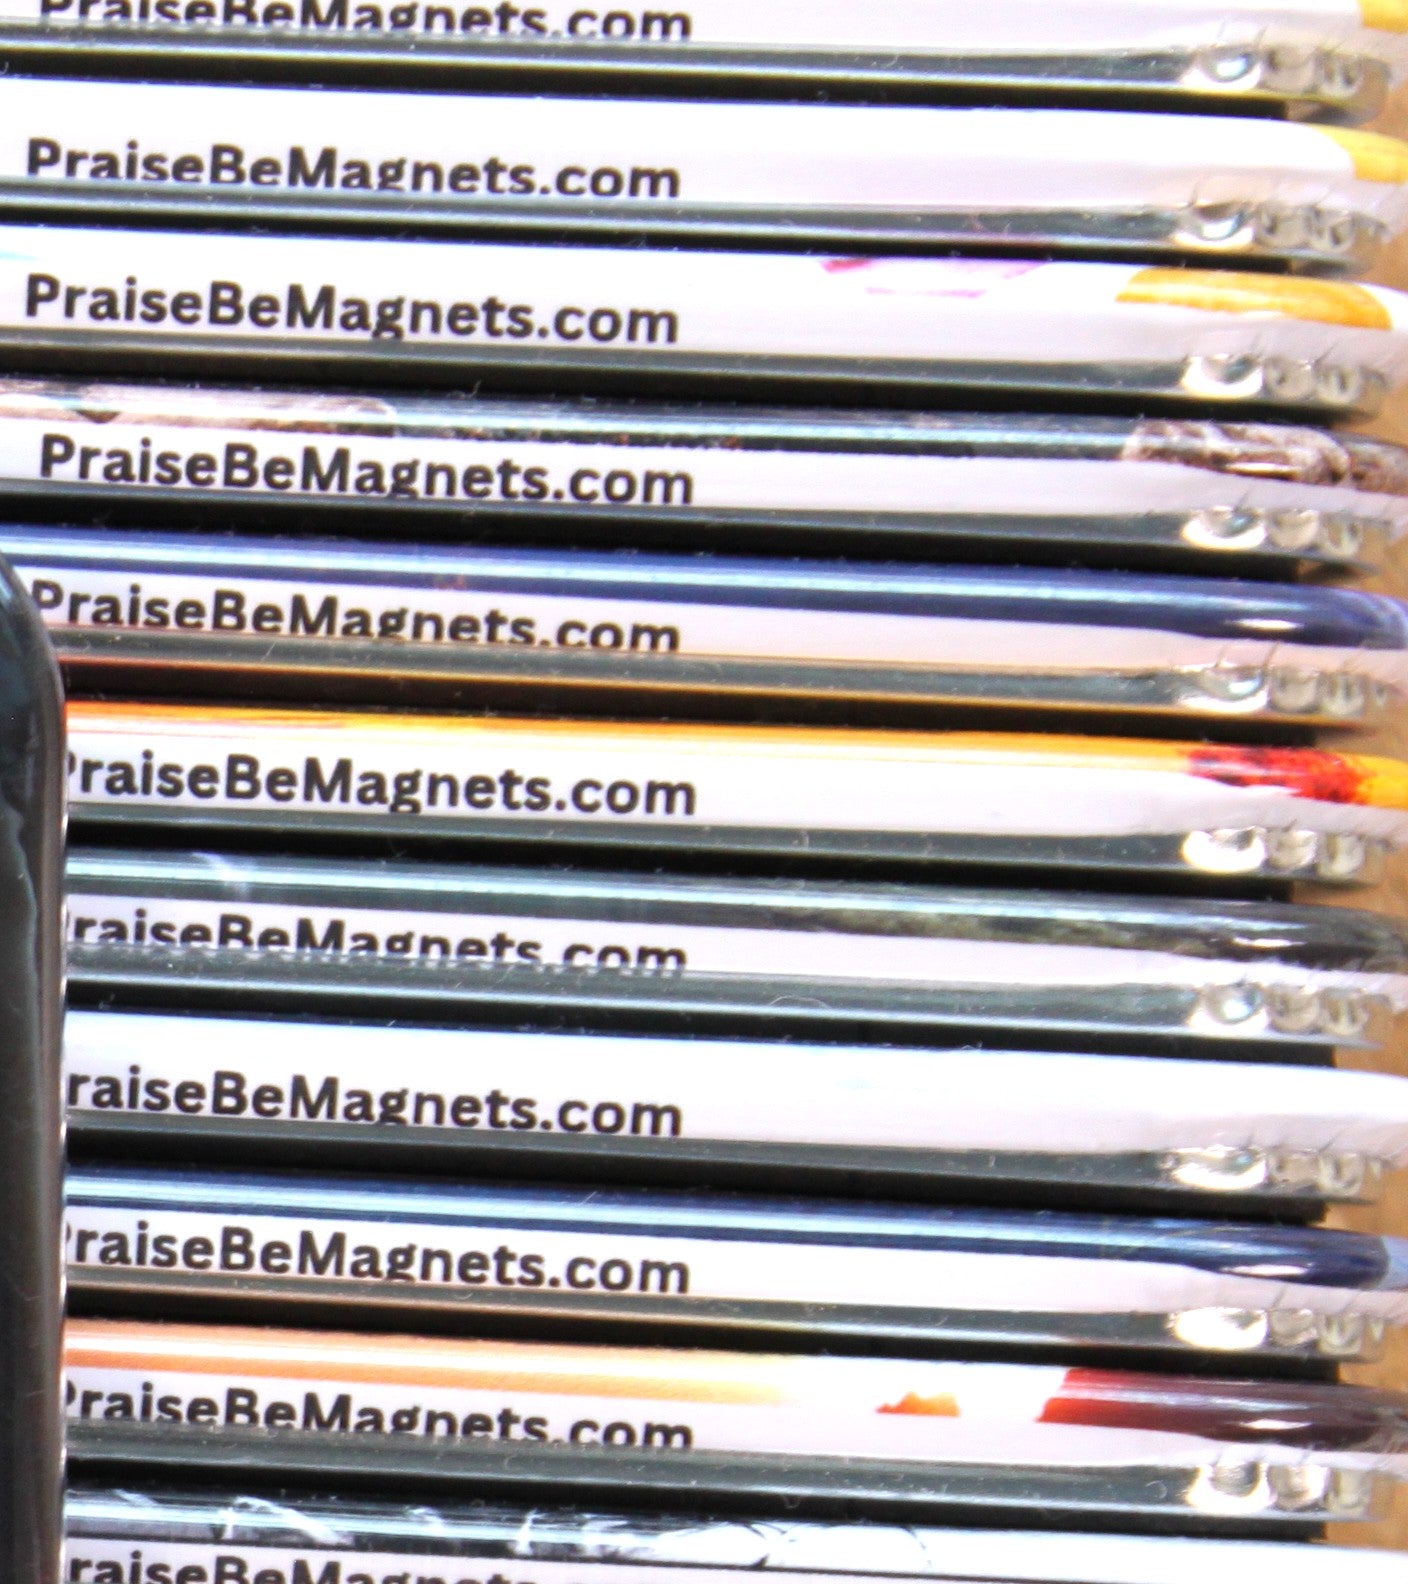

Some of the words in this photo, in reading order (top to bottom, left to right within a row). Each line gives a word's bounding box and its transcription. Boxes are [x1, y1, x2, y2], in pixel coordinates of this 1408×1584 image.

[27, 137, 680, 198] PraiseBeMagnets.com
[26, 273, 678, 343] PraiseBeMagnets.com
[39, 434, 694, 505] PraiseBeMagnets.com
[68, 749, 696, 815] raiseBeMagnets.com
[66, 908, 687, 967] raiseBeMagnetscom
[68, 1065, 681, 1137] raiseBeMagnets.com
[66, 1221, 689, 1293] raiseBeMagnets.com
